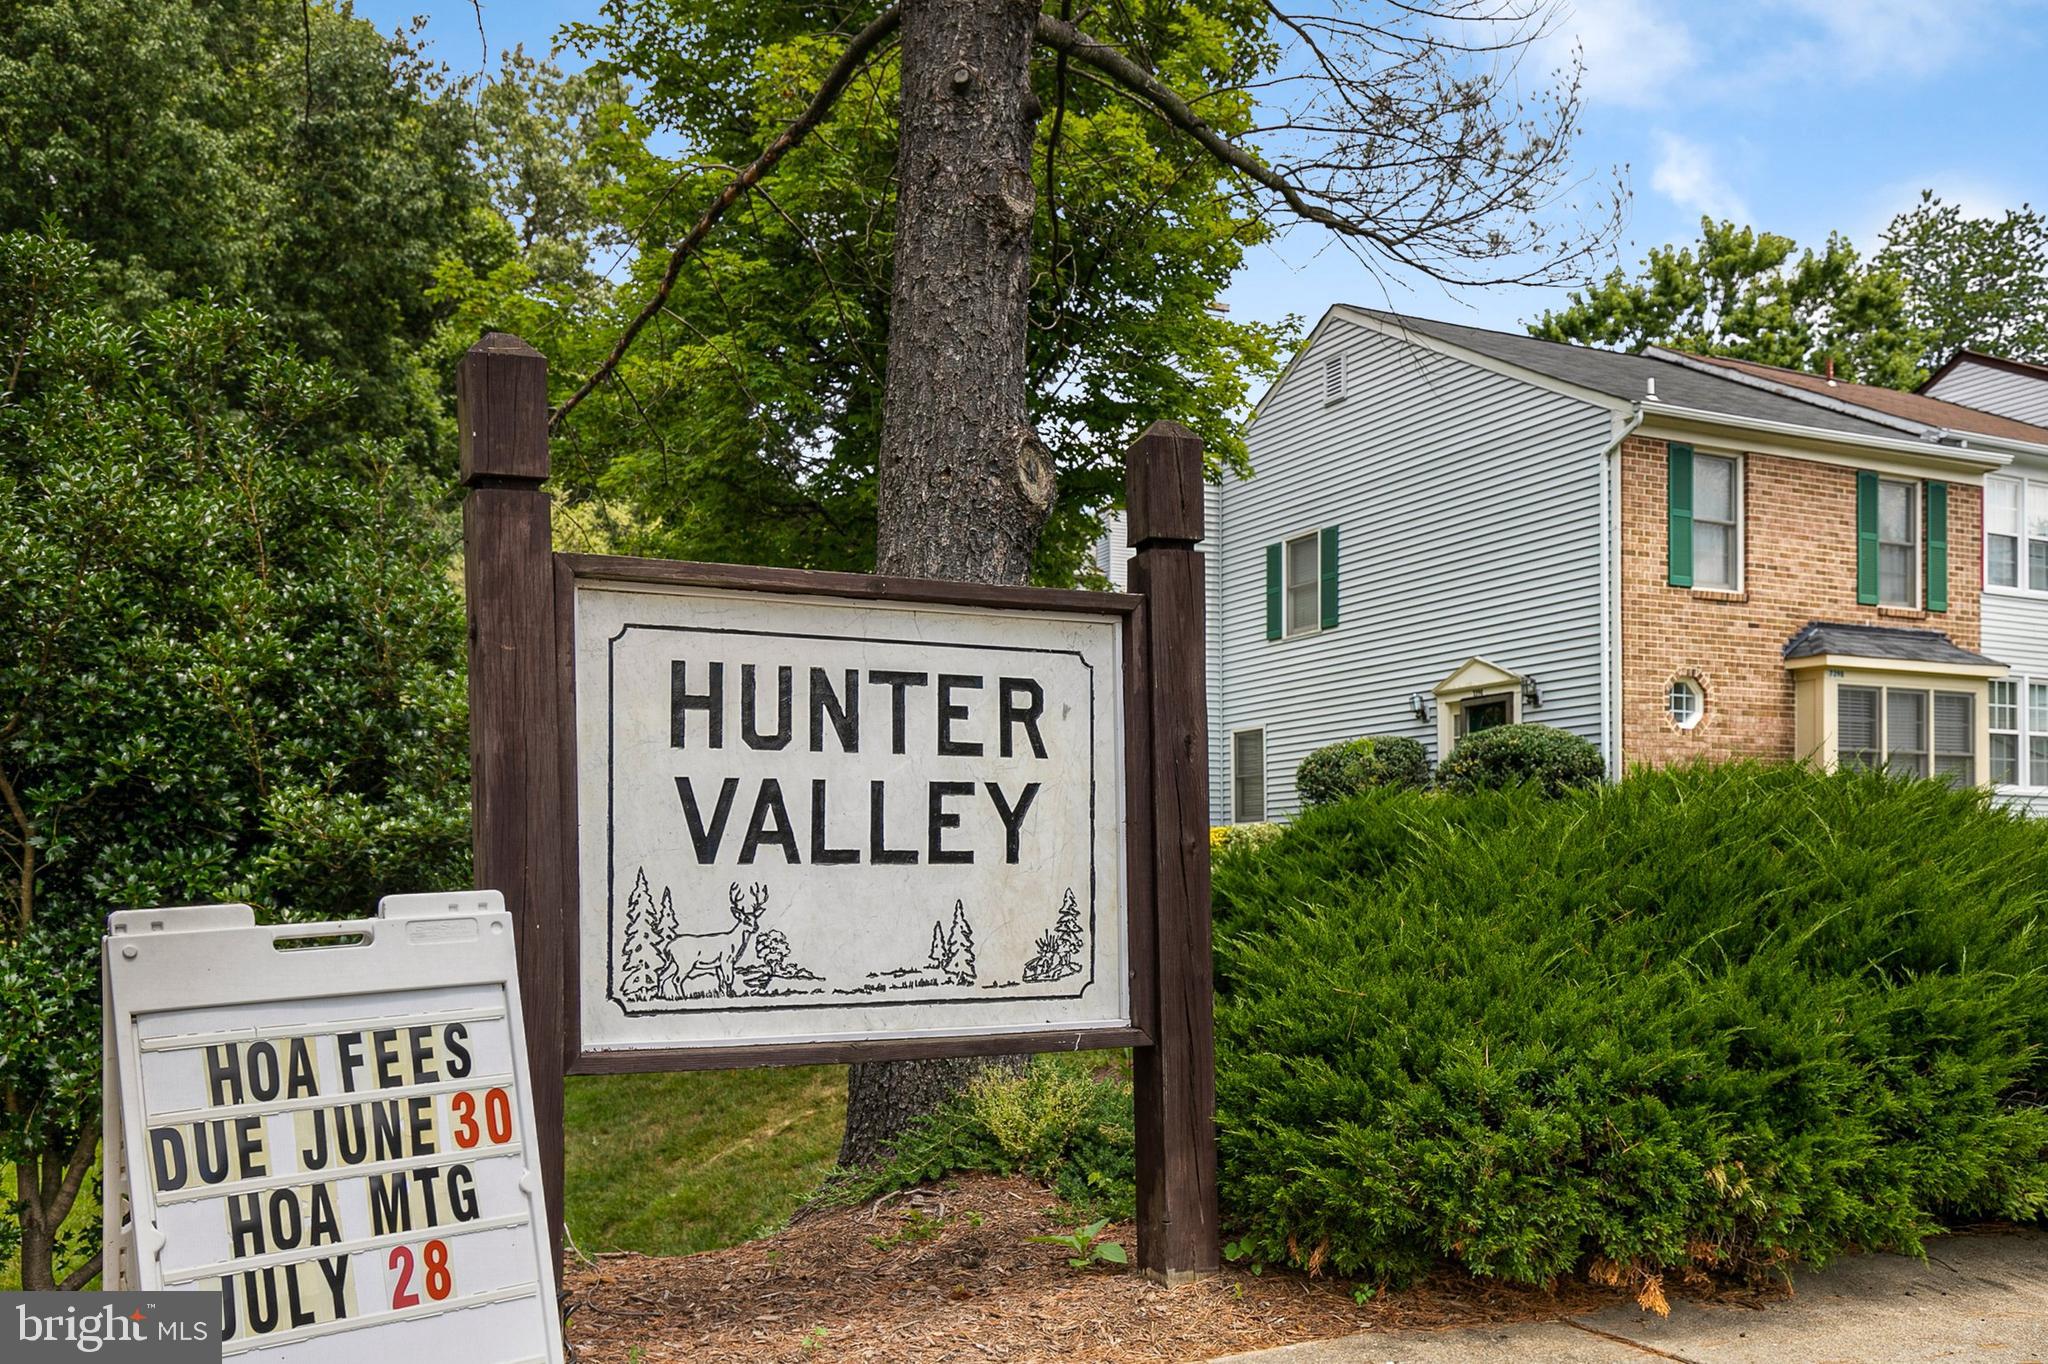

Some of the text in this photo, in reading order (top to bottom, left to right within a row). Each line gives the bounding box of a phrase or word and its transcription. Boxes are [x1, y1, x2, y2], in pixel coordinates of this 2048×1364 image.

[670, 659, 1048, 760] HUNTER
[674, 775, 1042, 866] VALLEY
[206, 1022, 472, 1106] HOA FEES
[152, 1087, 513, 1191] DUE JUNE 30
[228, 1164, 481, 1259] HOA MTG
[222, 1239, 453, 1342] JULY 28
